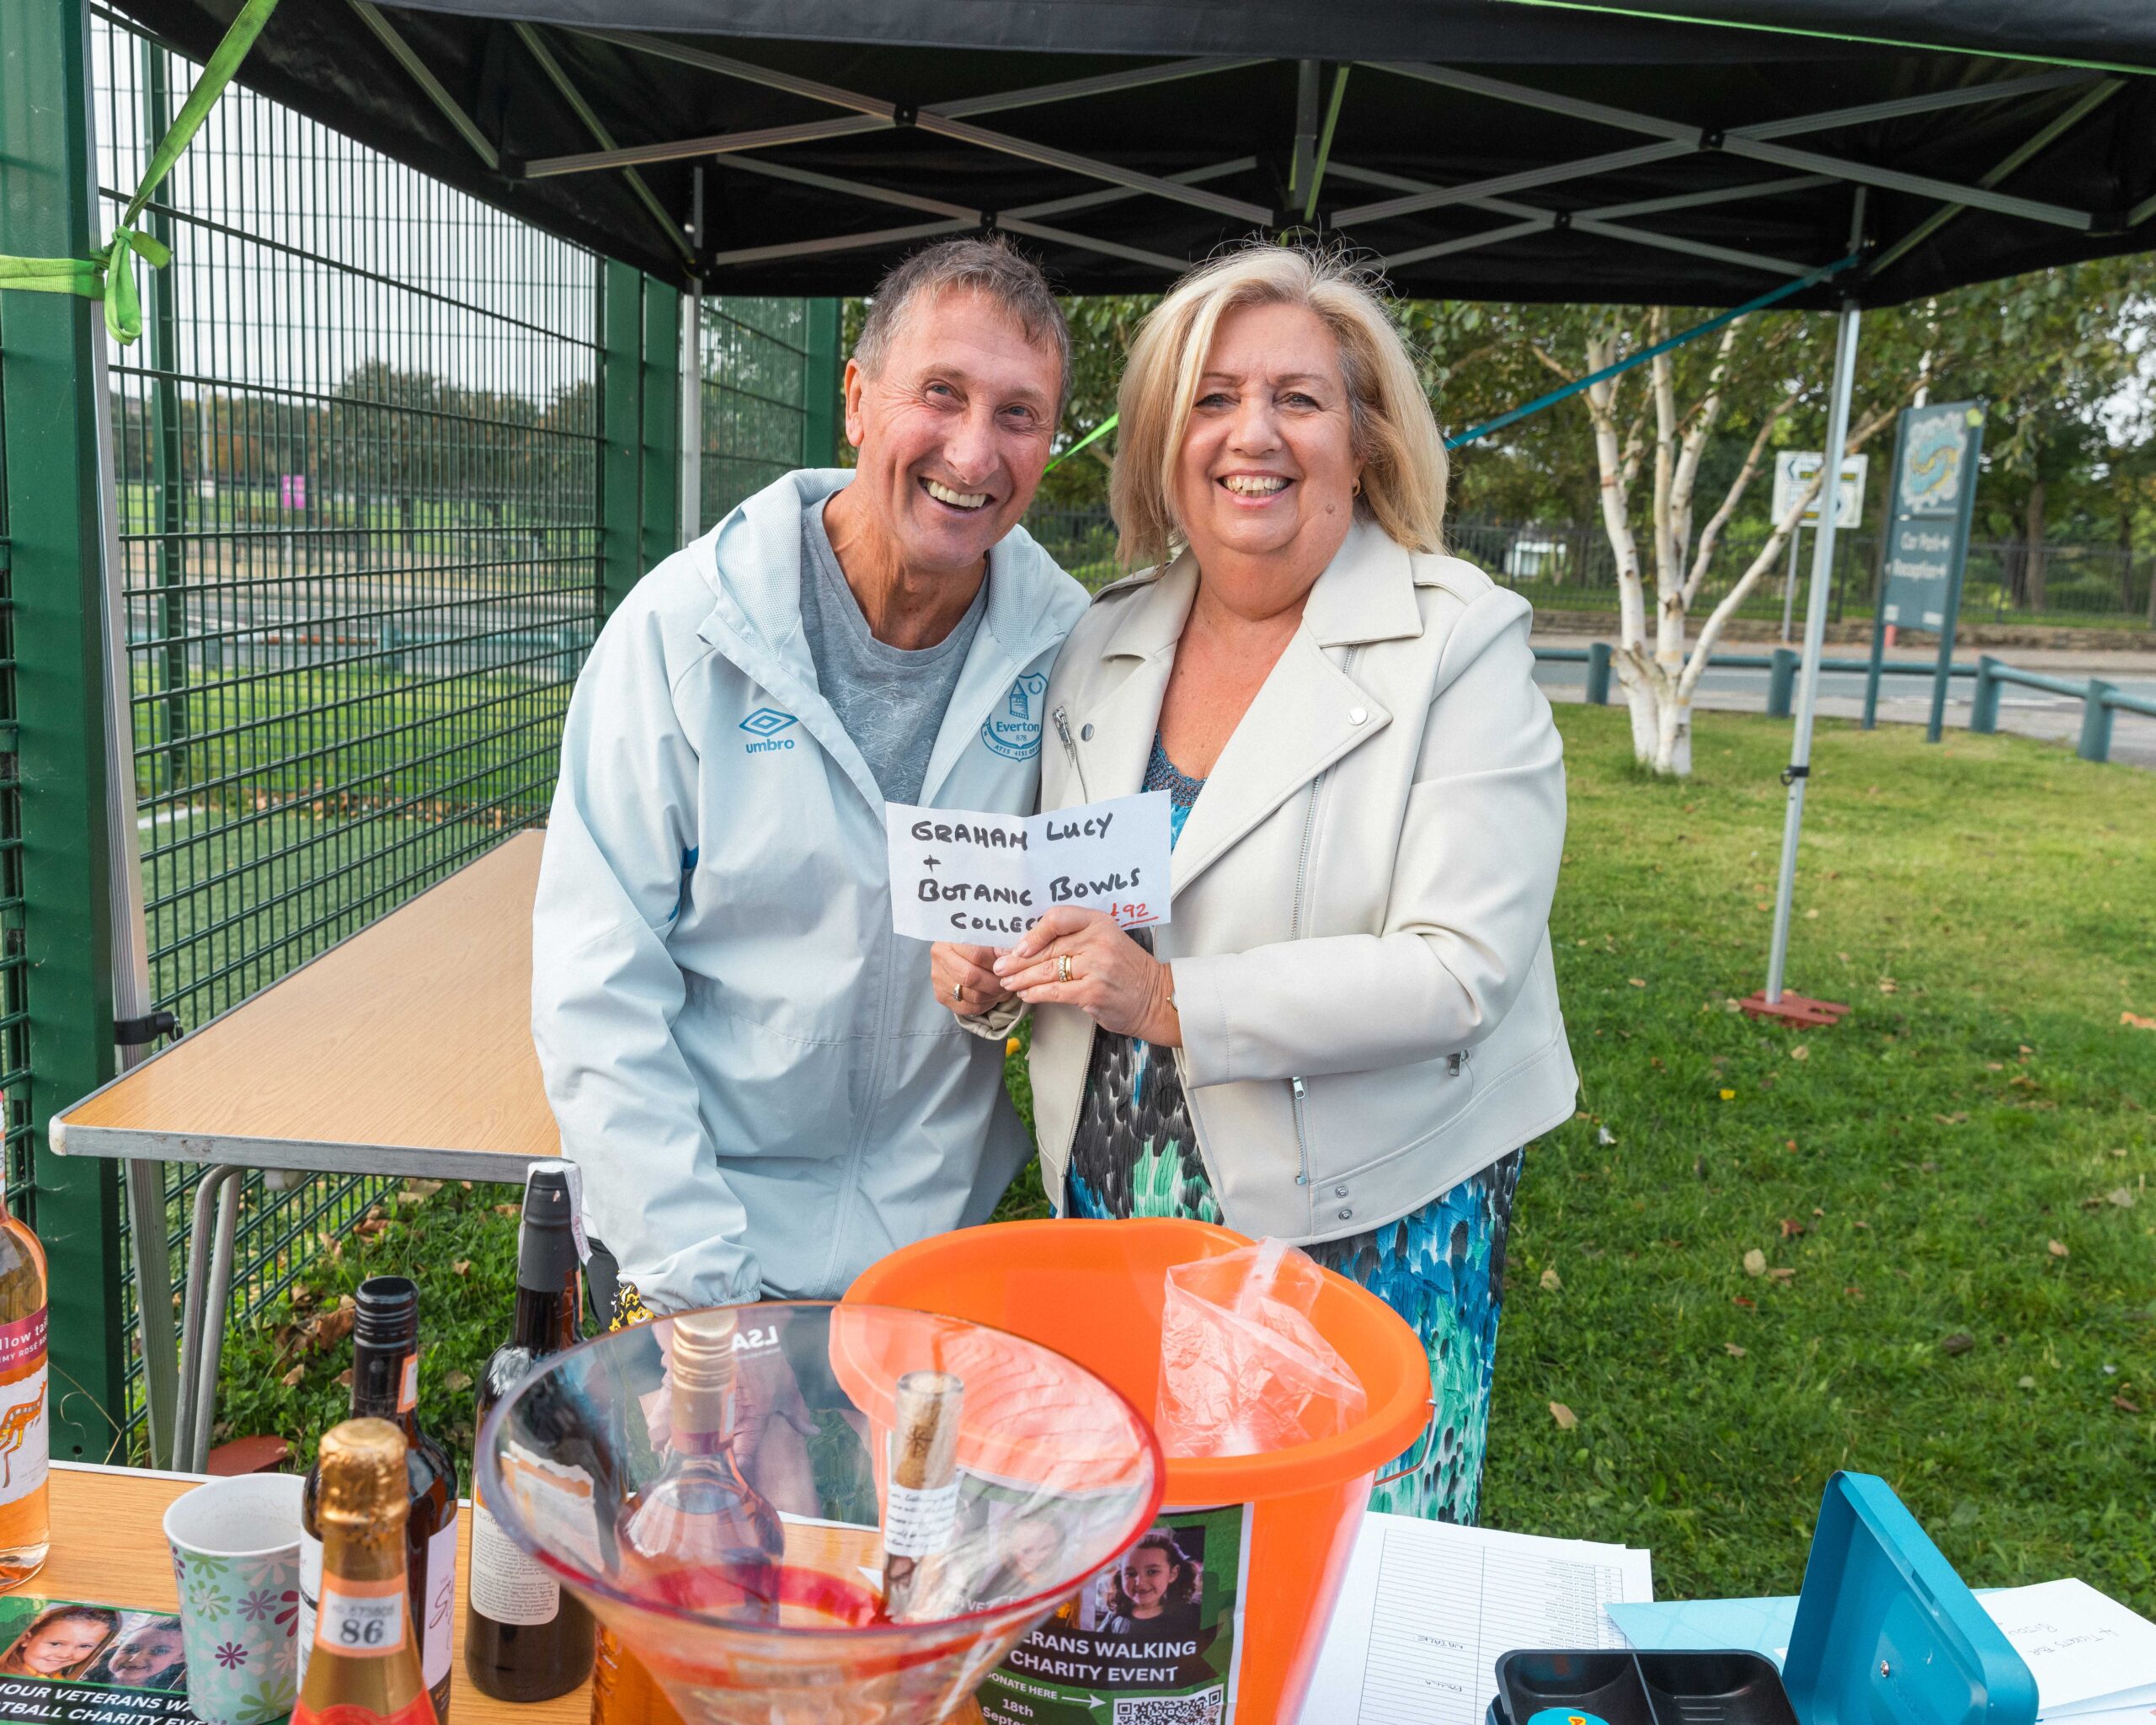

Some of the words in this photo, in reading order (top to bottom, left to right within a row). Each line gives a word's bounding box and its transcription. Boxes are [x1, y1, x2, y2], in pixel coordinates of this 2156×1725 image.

[996, 721, 1039, 732] Everton
[746, 739, 795, 753] umbro
[911, 820, 1028, 852] GRAHAM
[1046, 812, 1113, 841] LUCY
[918, 878, 1033, 907] BOTANIC
[1049, 868, 1140, 903] BOWLS
[950, 912, 1044, 934] COLLEC
[340, 1619, 384, 1643] 86
[1095, 1641, 1197, 1659] WALKING
[1010, 1649, 1102, 1681] CHARITY
[1107, 1666, 1179, 1683] EVENT
[55, 1688, 163, 1710] VETERANS
[1028, 1684, 1058, 1700] HERE
[67, 1708, 163, 1725] CHARITY
[1002, 1698, 1034, 1717] 18th
